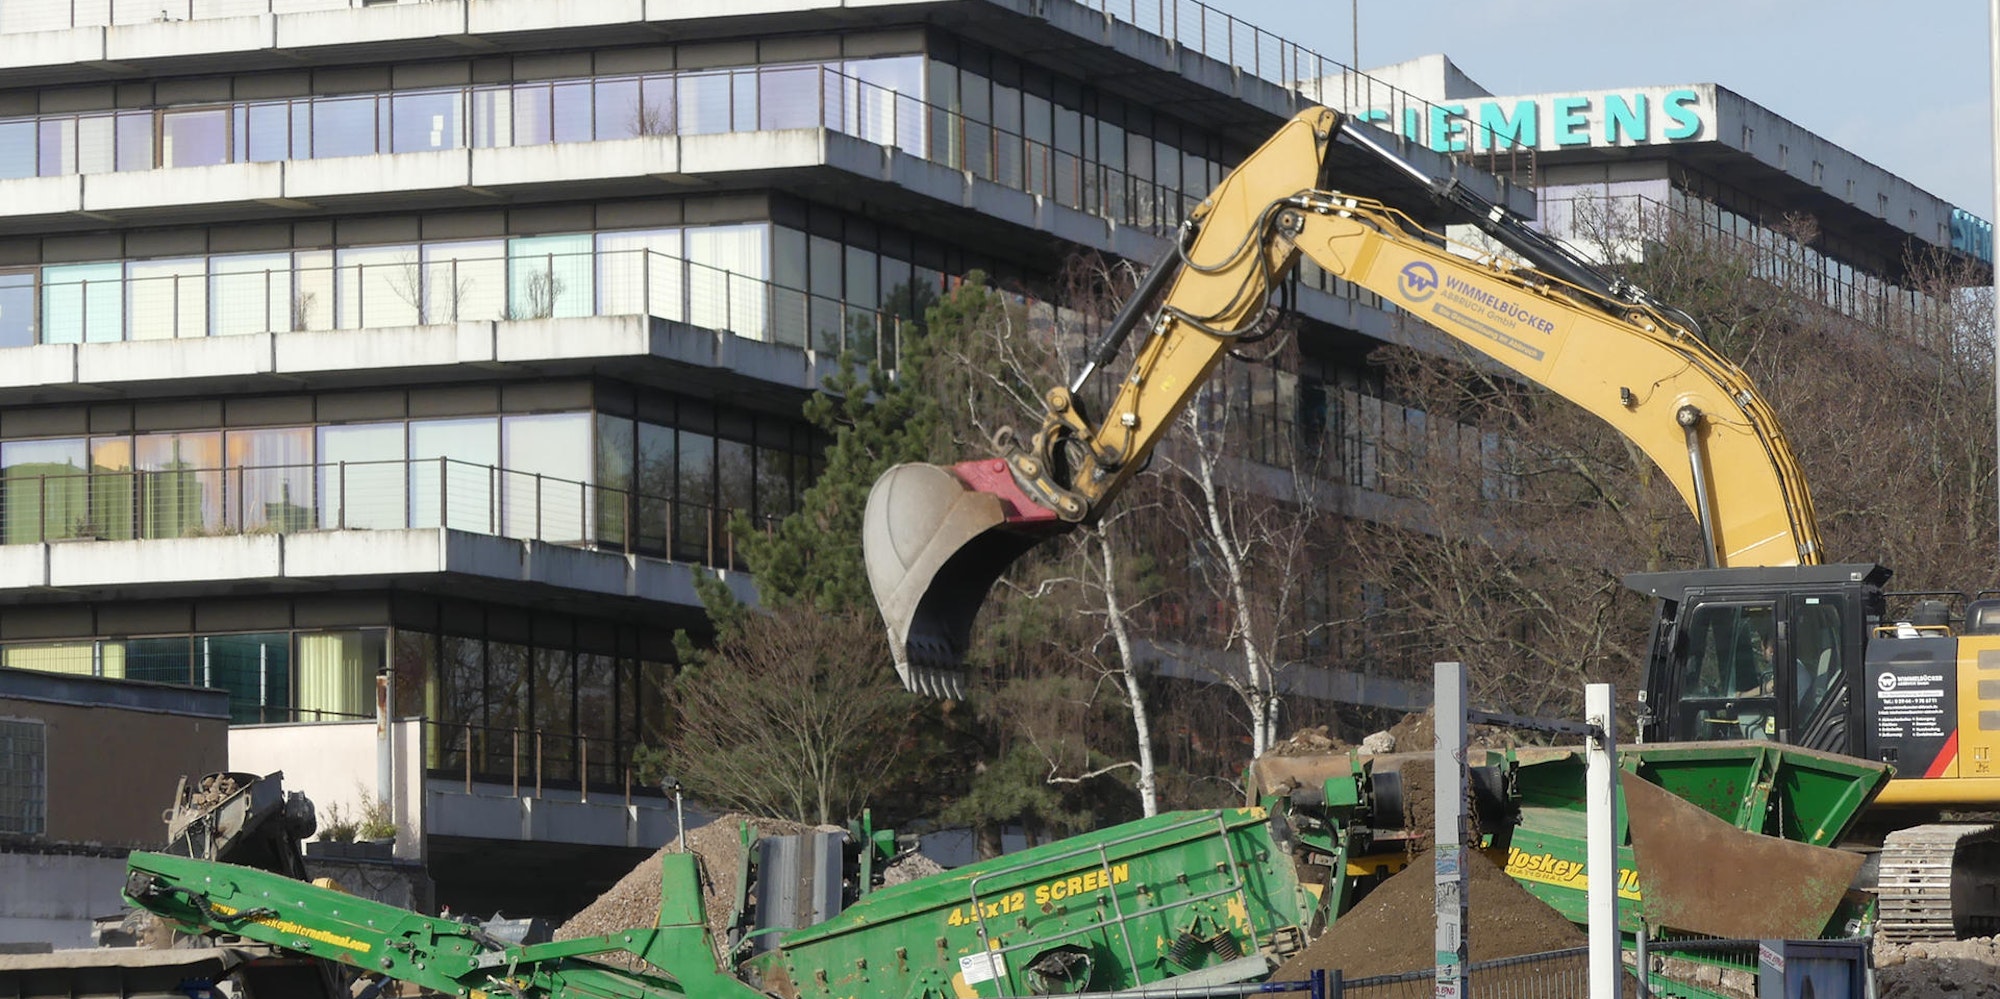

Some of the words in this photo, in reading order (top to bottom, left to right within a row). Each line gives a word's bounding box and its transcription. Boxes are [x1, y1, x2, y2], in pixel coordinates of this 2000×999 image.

[1440, 290, 1485, 315] ABBRUCH
[1487, 310, 1516, 329] GmbH
[1446, 275, 1555, 335] WIMMELBÜCKER
[1507, 846, 1584, 882] loskey
[948, 892, 1025, 927] 4.5x12
[1034, 863, 1129, 905] SCREEN
